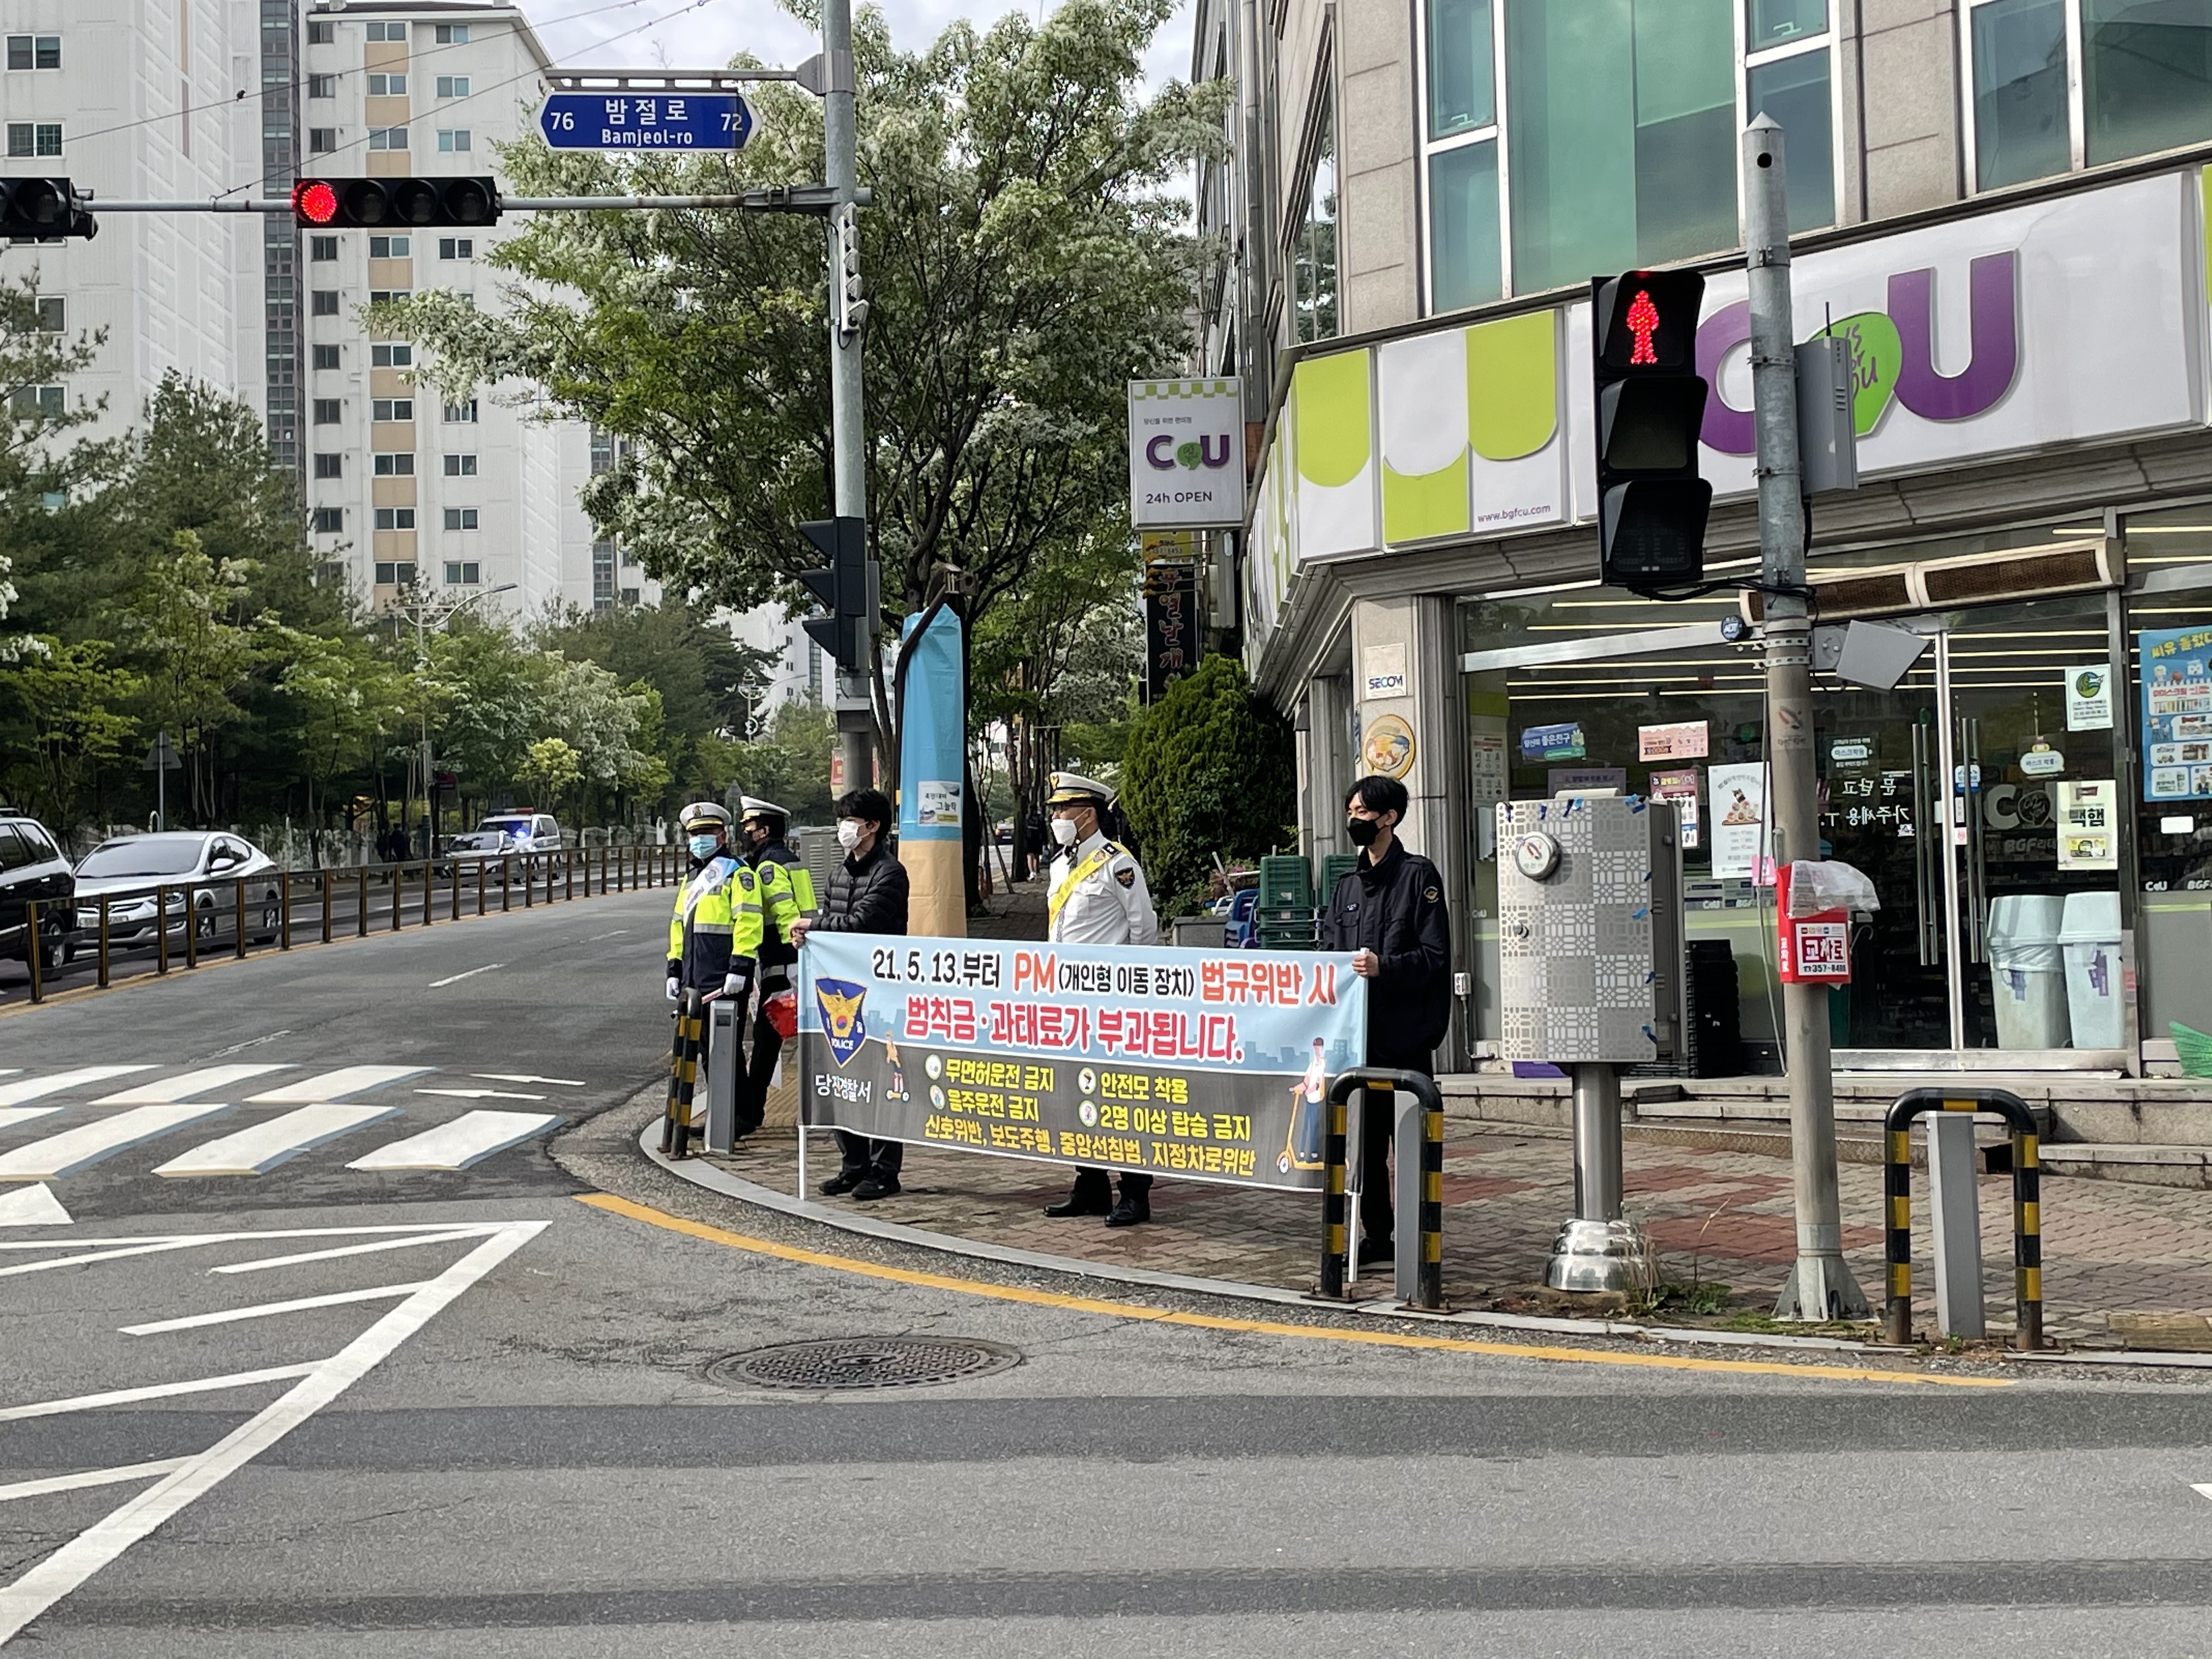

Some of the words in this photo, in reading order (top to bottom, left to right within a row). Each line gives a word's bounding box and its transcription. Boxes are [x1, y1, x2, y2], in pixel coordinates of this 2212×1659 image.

[550, 112, 574, 131] 76
[720, 114, 743, 132] 72
[601, 129, 693, 147] Bamjeol-ro
[1146, 493, 1170, 504] 24h
[1175, 492, 1212, 503] OPEN
[1477, 505, 1551, 523] www.bgfcu.com
[1369, 675, 1403, 690] SECOM
[1805, 938, 1843, 961] 교차로
[1117, 966, 1149, 995] 이동
[1154, 967, 1195, 997] 장치)
[1201, 961, 1302, 1005] 법규위반
[1308, 964, 1336, 1005] 시
[1098, 1009, 1243, 1061] 부과됩니다.
[815, 1073, 871, 1103] 당진경찰서
[945, 1058, 1020, 1089] 무면허운전
[1024, 1065, 1054, 1092] 금지
[1101, 1072, 1149, 1101] 안전모
[1155, 1076, 1188, 1104] 착용
[948, 1089, 1005, 1118] 음주운전
[1008, 1094, 1040, 1122] 금지
[1101, 1105, 1128, 1131] 2명
[1133, 1108, 1167, 1136] 이상
[1171, 1111, 1208, 1139] 탑승
[1214, 1113, 1251, 1142] 금지
[924, 1115, 987, 1146] 신호위반,
[990, 1124, 1056, 1156] 보도주행,
[1059, 1132, 1147, 1167] 중앙선침범,
[1152, 1142, 1256, 1176] 지정차로위반
